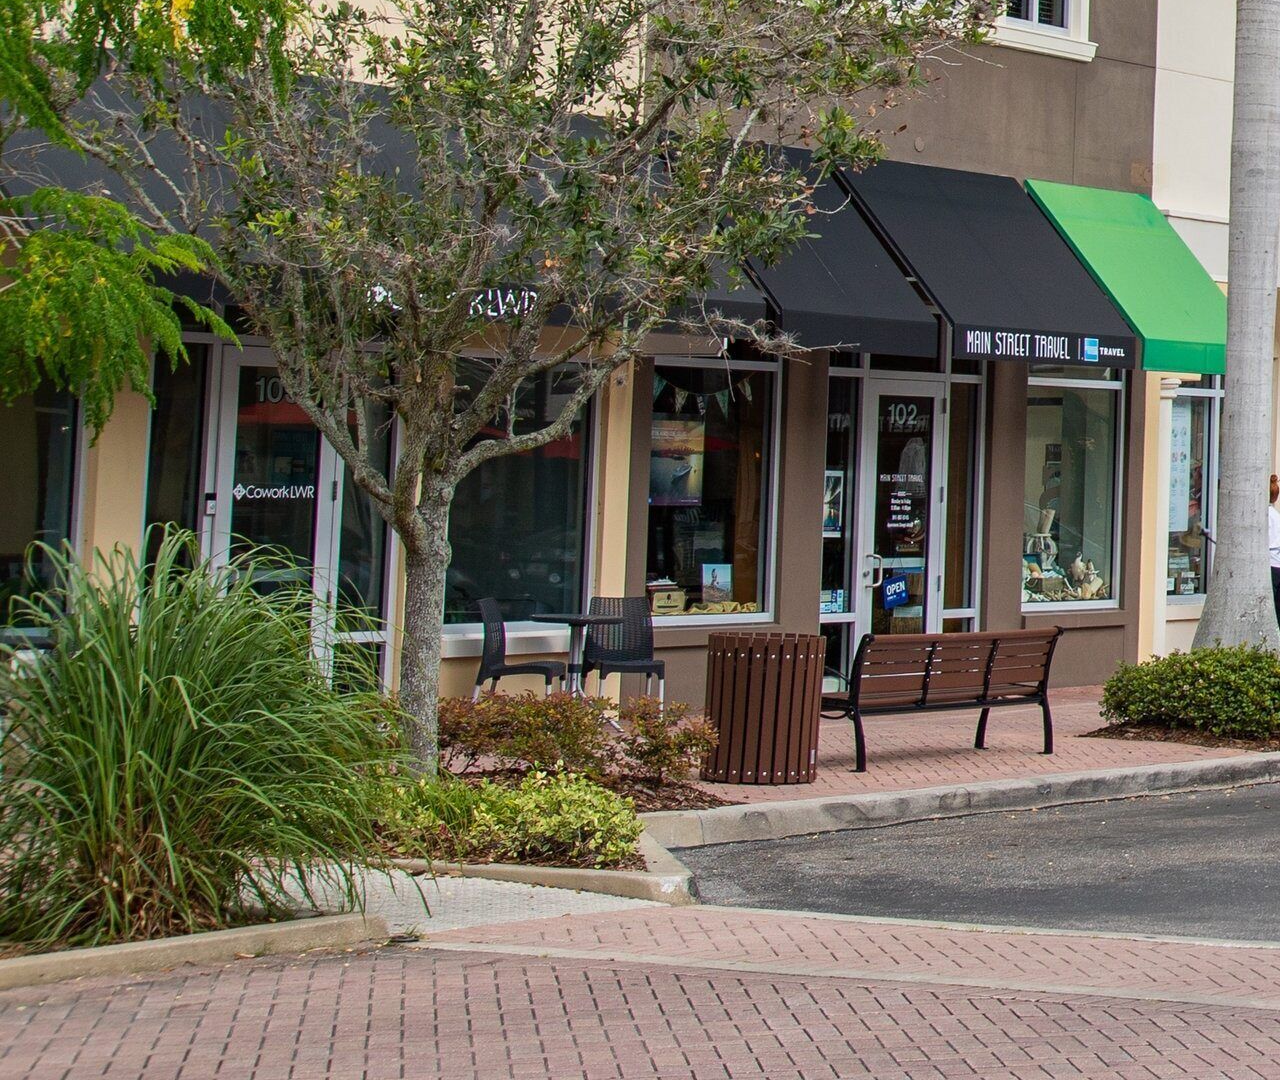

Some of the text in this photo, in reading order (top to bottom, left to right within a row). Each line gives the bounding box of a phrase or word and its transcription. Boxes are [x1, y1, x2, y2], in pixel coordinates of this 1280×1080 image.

[966, 330, 991, 354] MAIN
[995, 332, 1031, 357] STREET
[1034, 335, 1070, 360] TRAVEL
[1099, 347, 1125, 357] TRAVEL
[888, 403, 917, 425] 102
[886, 581, 906, 595] OPEN
